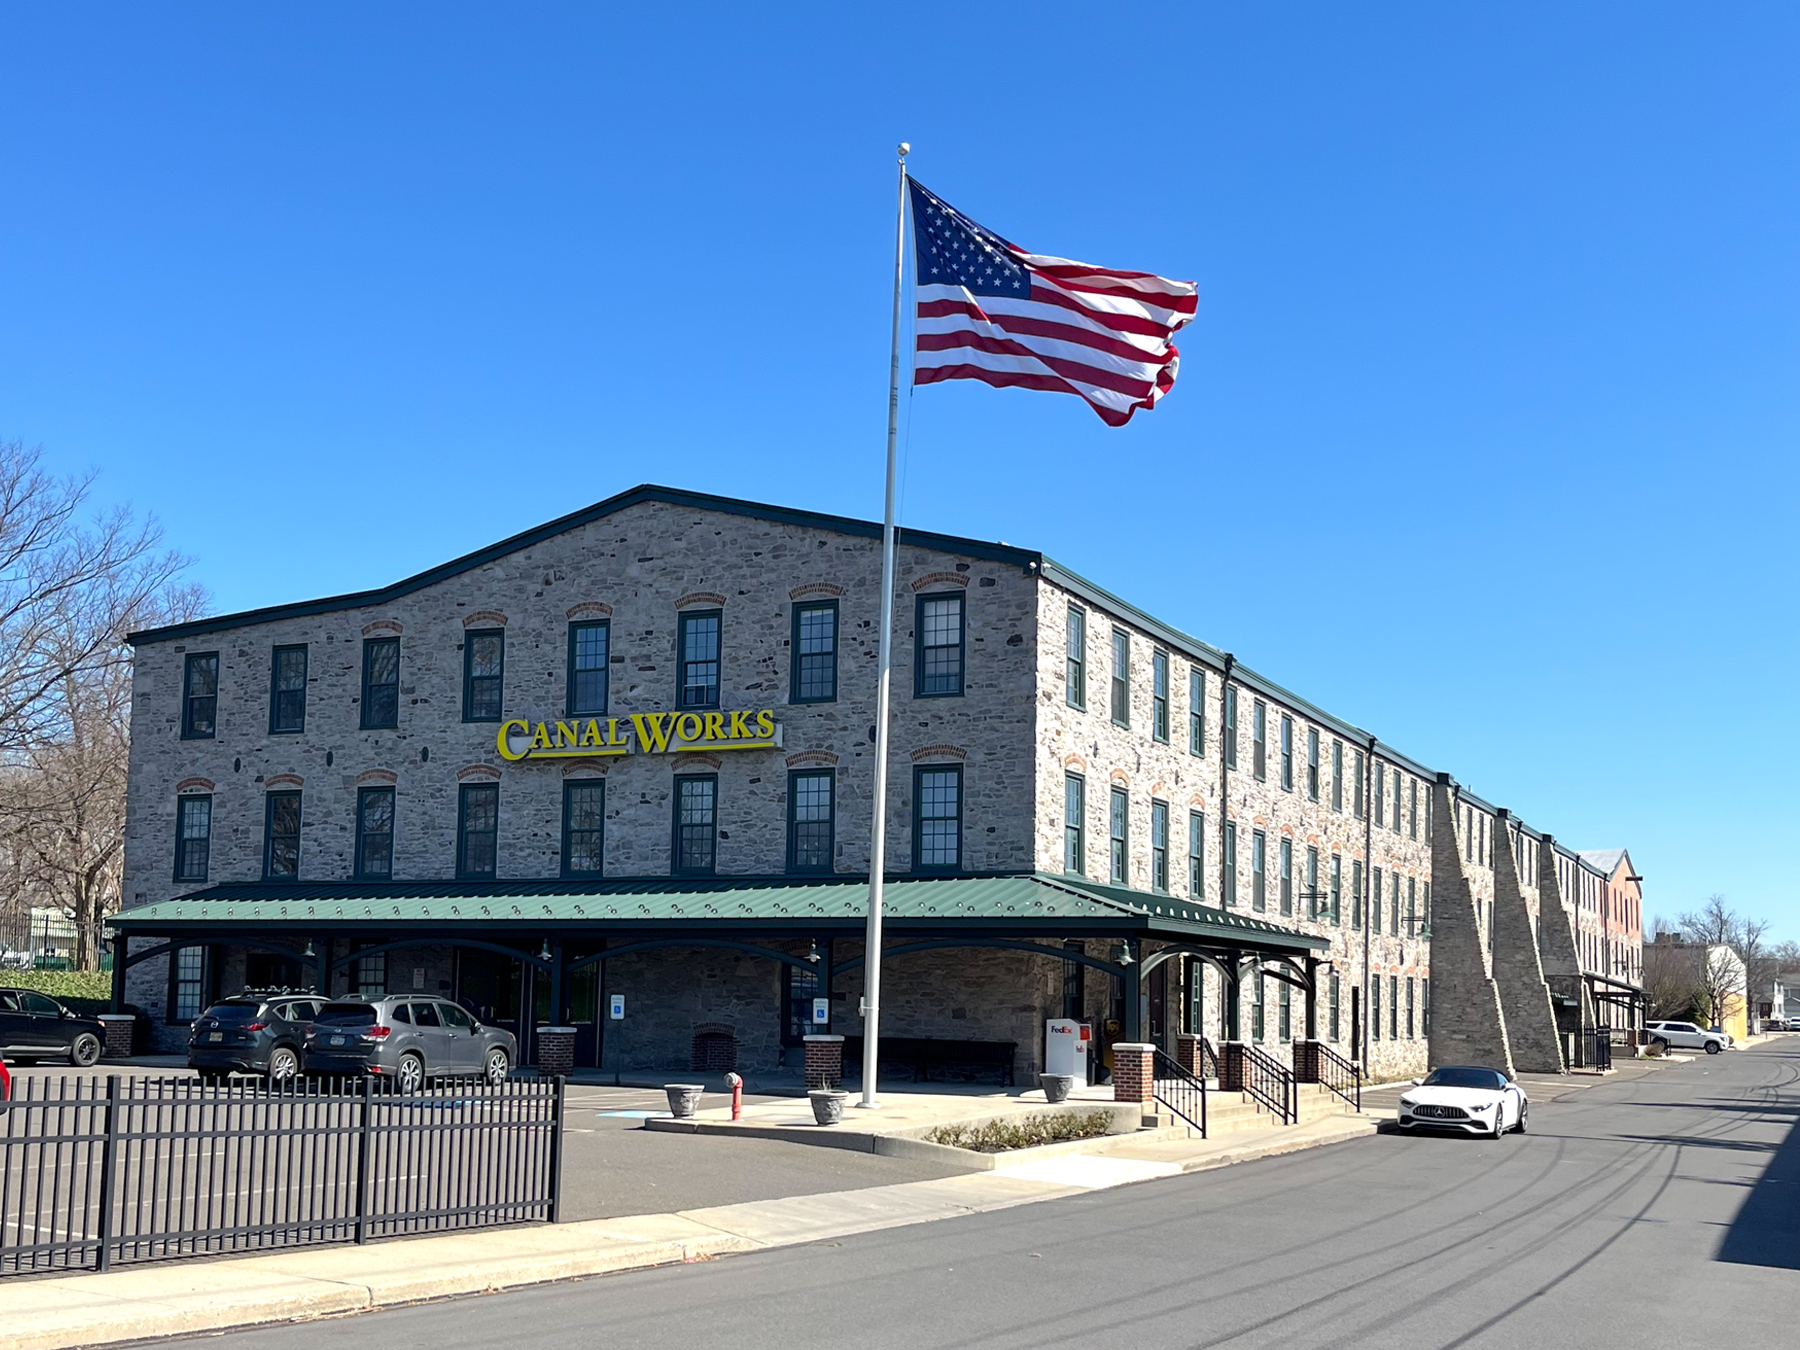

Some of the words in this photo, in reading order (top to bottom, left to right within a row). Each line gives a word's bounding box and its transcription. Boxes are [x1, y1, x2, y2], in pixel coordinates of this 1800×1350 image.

[497, 718, 627, 761] CANAL
[629, 709, 775, 753] WORKS
[1051, 1025, 1073, 1034] FedEx
